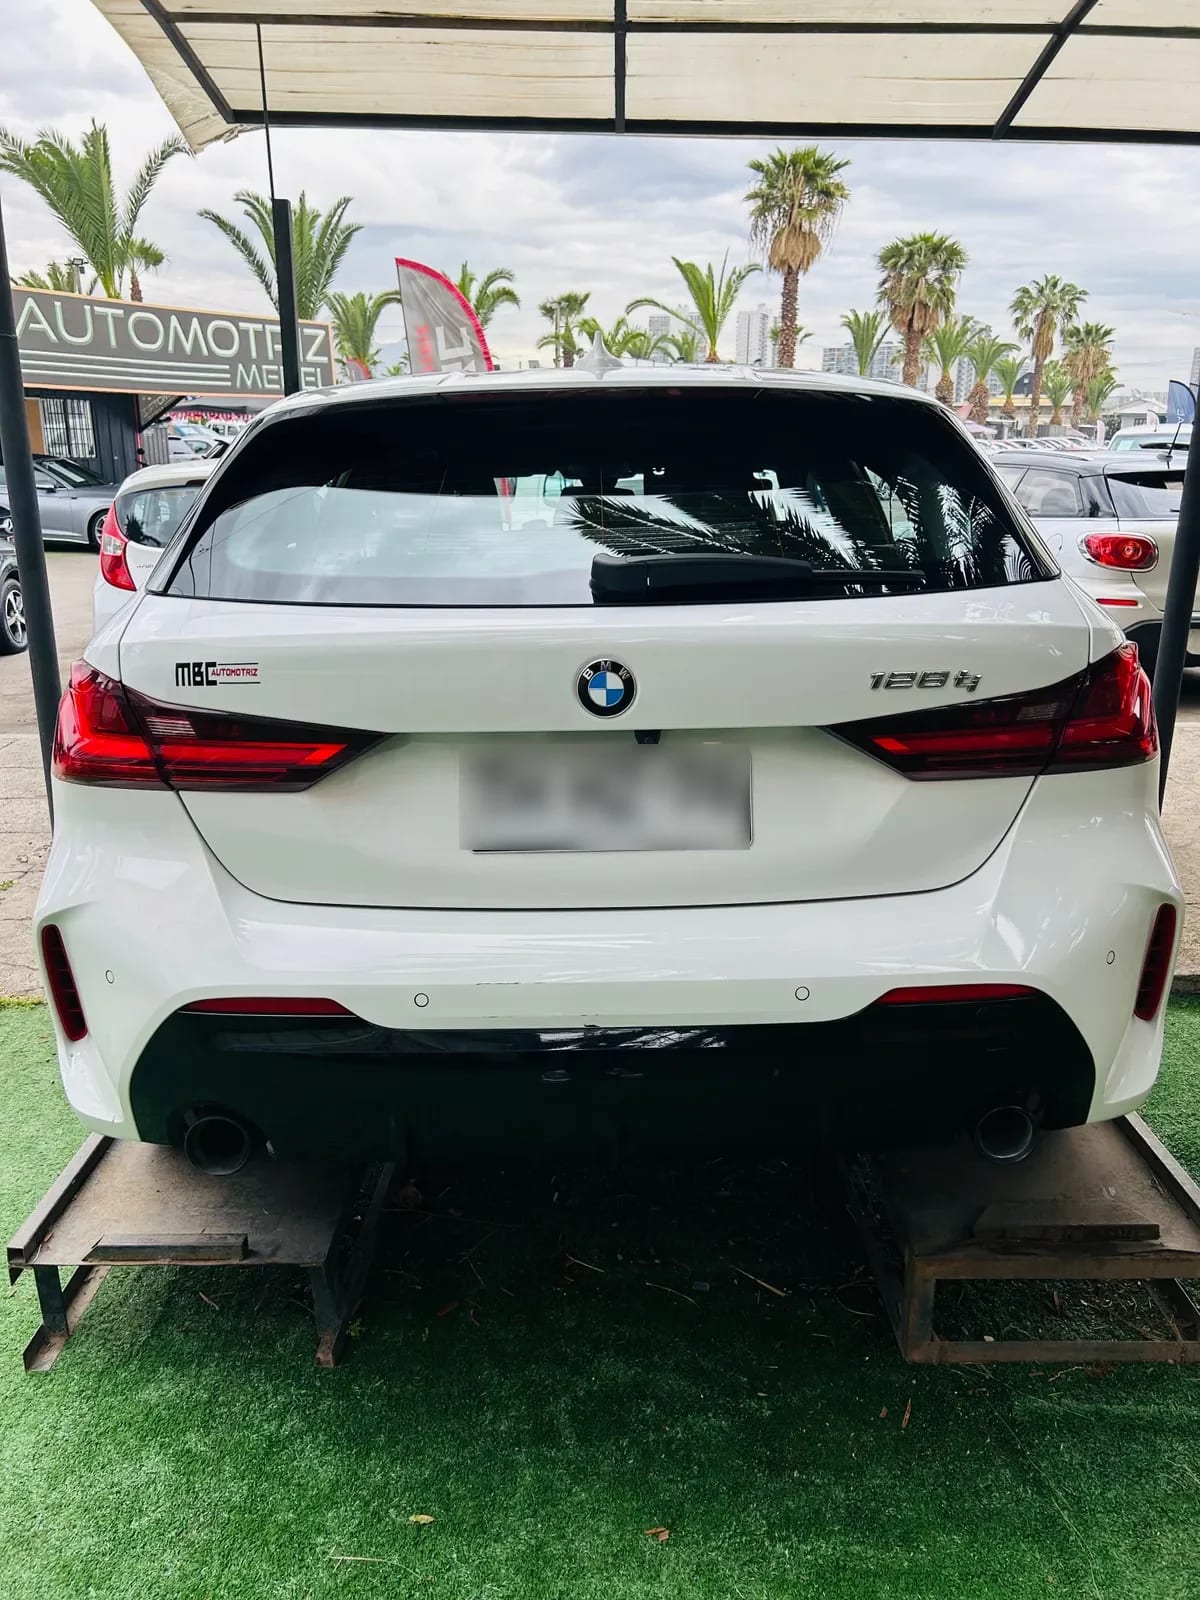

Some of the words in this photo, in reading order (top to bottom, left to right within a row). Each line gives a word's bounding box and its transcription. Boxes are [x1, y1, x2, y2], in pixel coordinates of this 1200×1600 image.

[236, 363, 323, 390] MEEL
[175, 662, 218, 686] MBC
[211, 668, 259, 677] AUTOMOTRIZ
[582, 661, 631, 680] BMW
